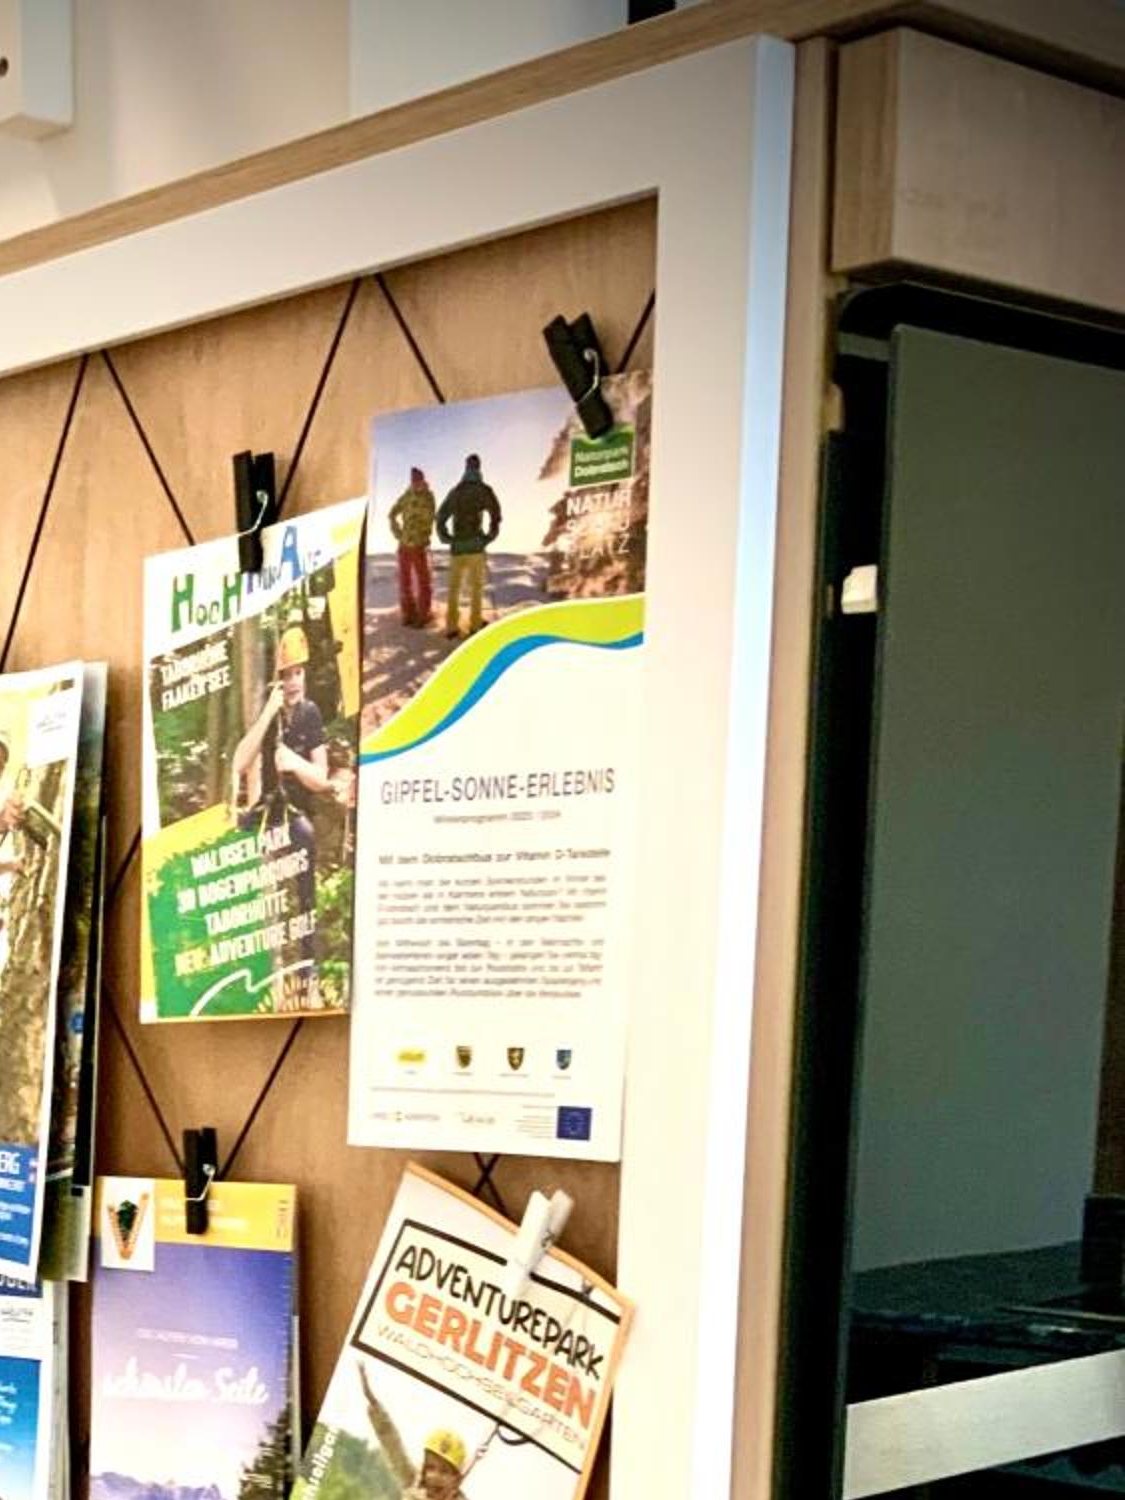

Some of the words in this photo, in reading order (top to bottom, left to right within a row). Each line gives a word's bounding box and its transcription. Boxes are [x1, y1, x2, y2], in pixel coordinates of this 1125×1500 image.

[380, 767, 616, 805] GIPFEL-SONNE-ERLEBNIS
[384, 1281, 596, 1430] GERLITZEN
[394, 1244, 604, 1381] ADVENTUREPARK
